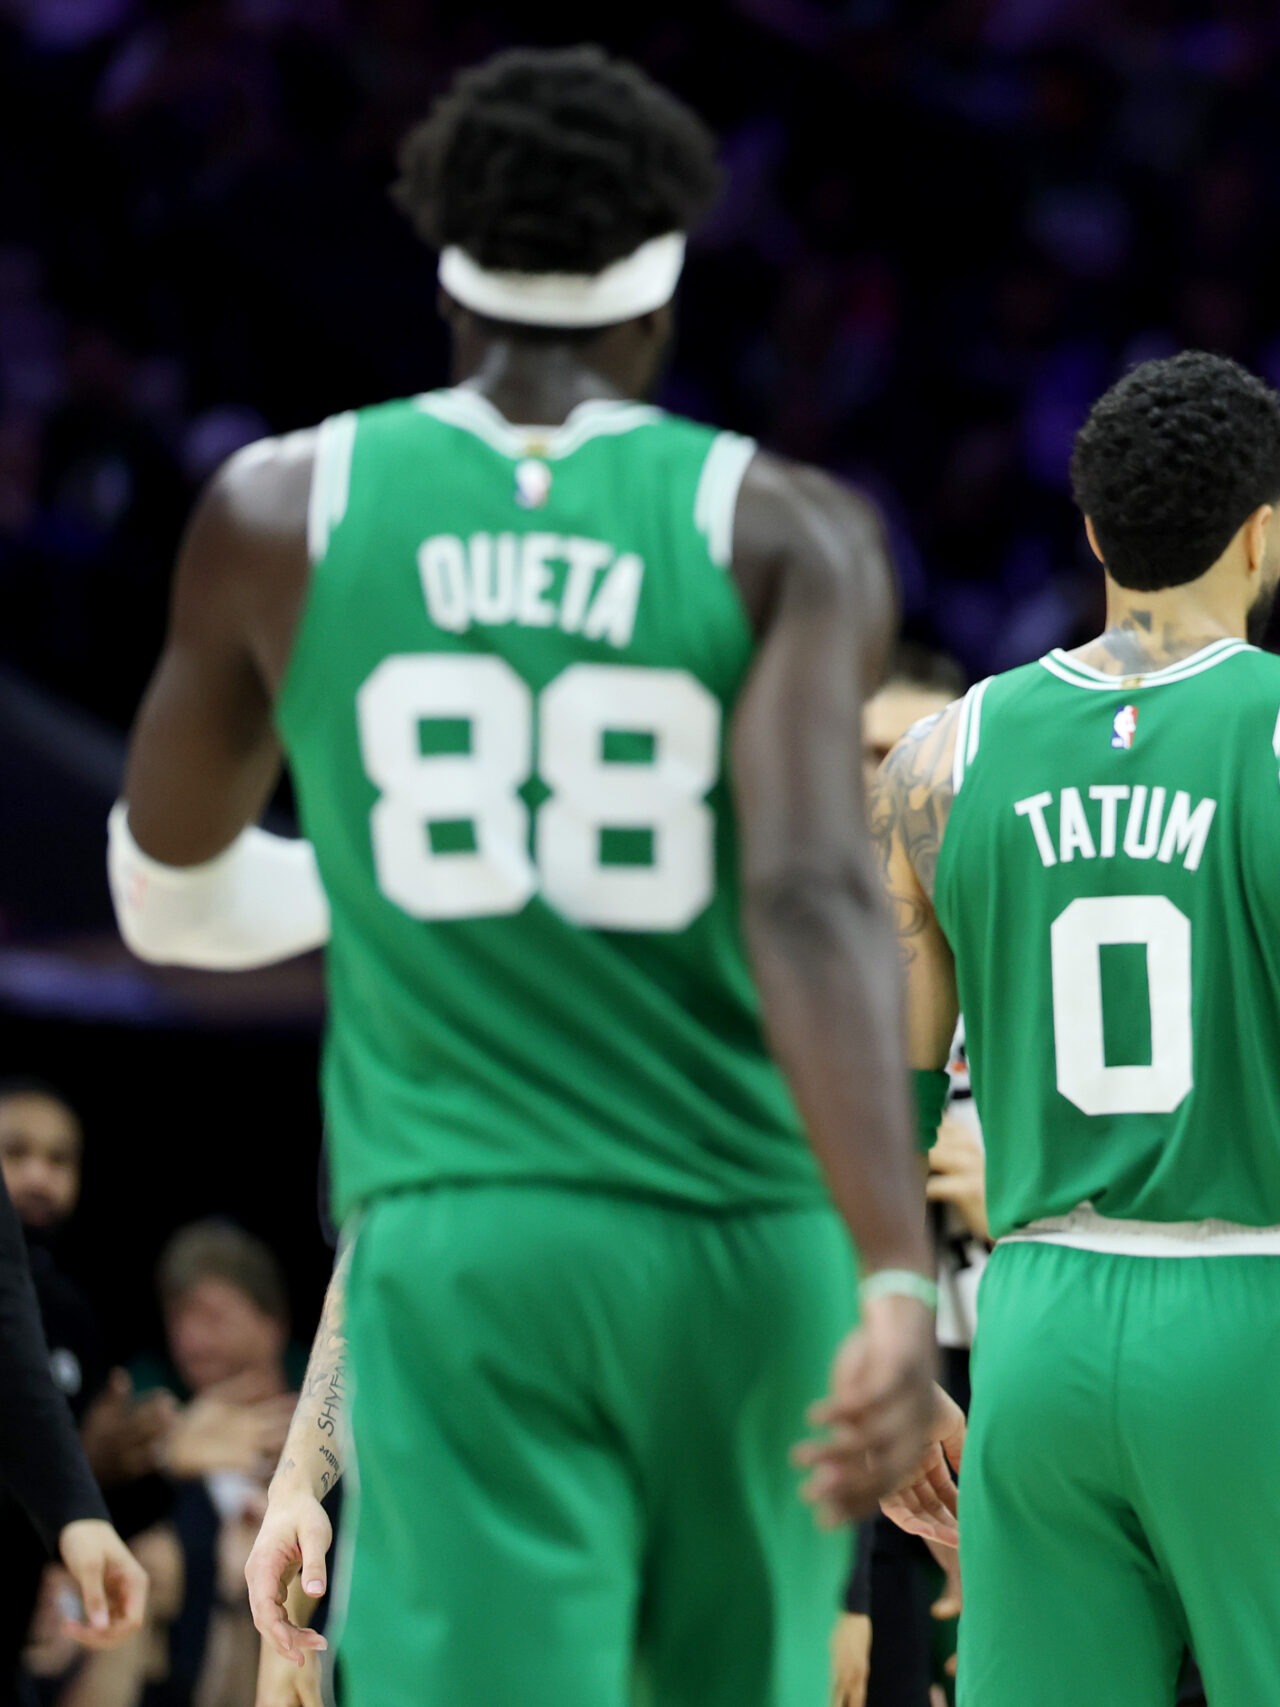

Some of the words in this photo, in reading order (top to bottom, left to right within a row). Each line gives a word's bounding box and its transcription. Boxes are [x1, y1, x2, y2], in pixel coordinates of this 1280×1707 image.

[417, 531, 644, 648] QUETA
[356, 652, 722, 933] 88
[1014, 784, 1217, 872] TATUM
[1050, 895, 1193, 1116] 0
